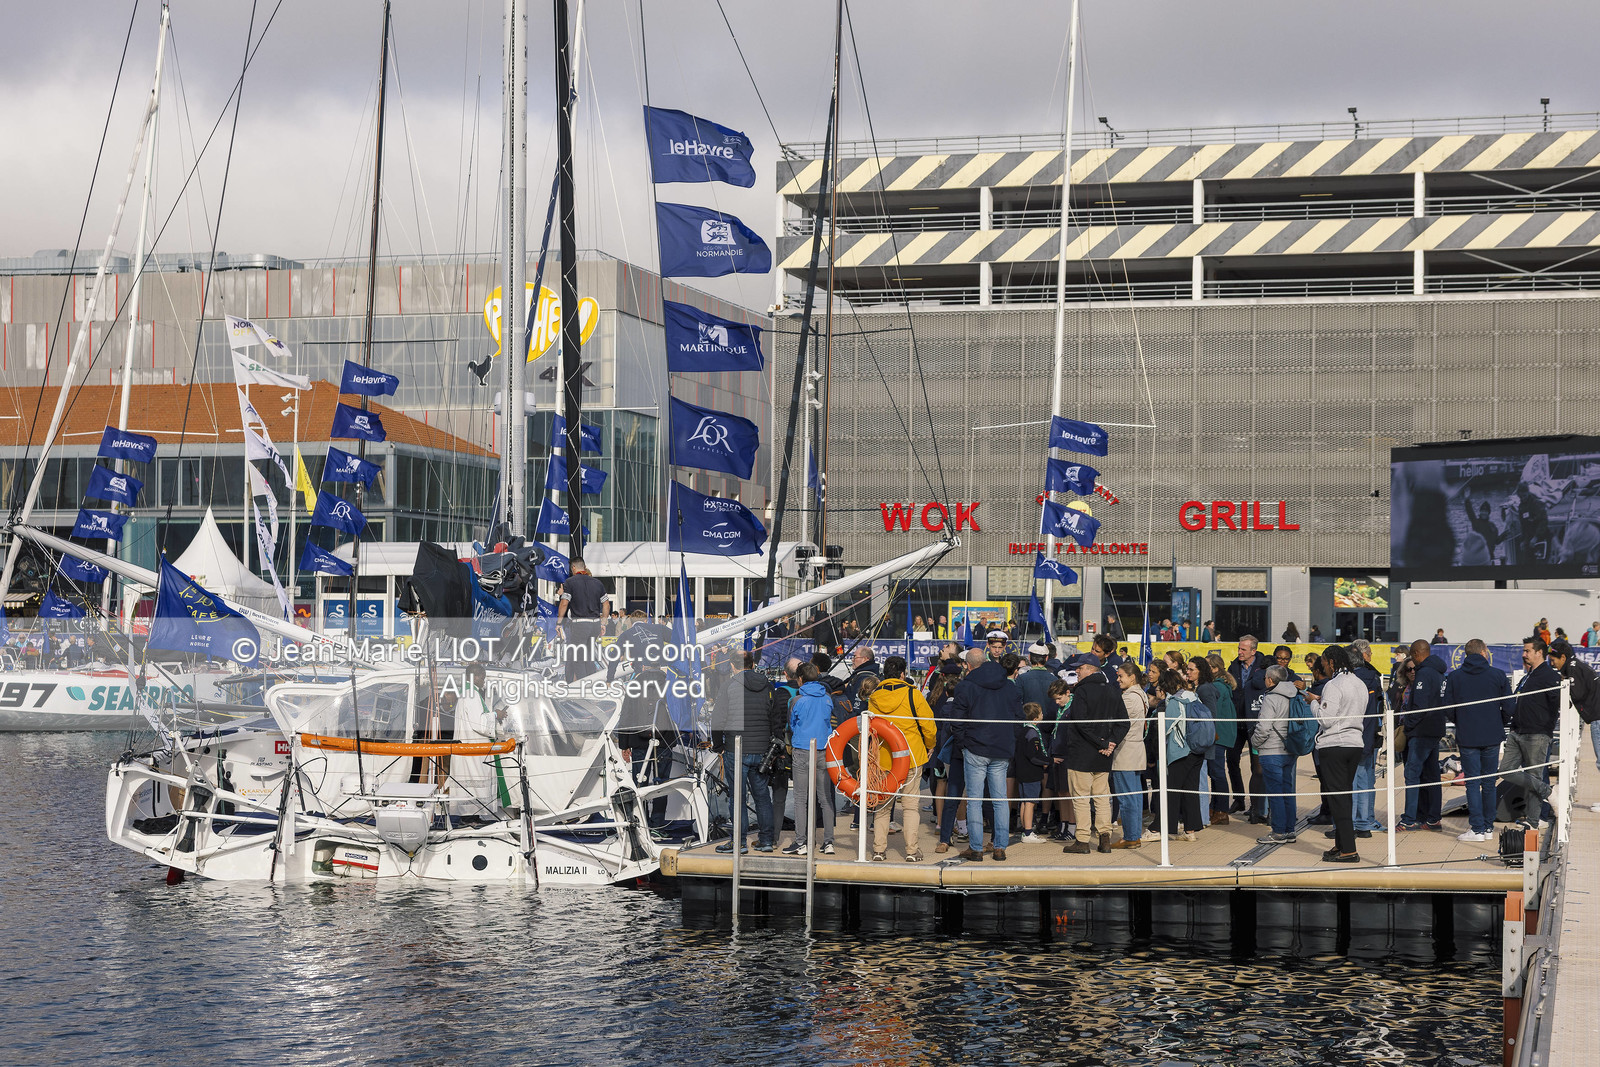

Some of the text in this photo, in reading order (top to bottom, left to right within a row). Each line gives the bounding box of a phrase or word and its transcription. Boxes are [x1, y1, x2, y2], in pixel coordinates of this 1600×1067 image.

[669, 138, 734, 159] leHavre
[696, 248, 744, 258] NORMANDIE
[680, 343, 748, 355] MARTINIQUE
[353, 374, 387, 384] leHavre
[1061, 430, 1097, 445] leHavre
[111, 440, 144, 451] leHavre
[880, 502, 981, 532] WOK
[1179, 500, 1300, 531] GRILL
[702, 530, 741, 539] CMA CGM
[1009, 543, 1063, 555] BUFFT
[545, 866, 581, 875] MALIZIA
